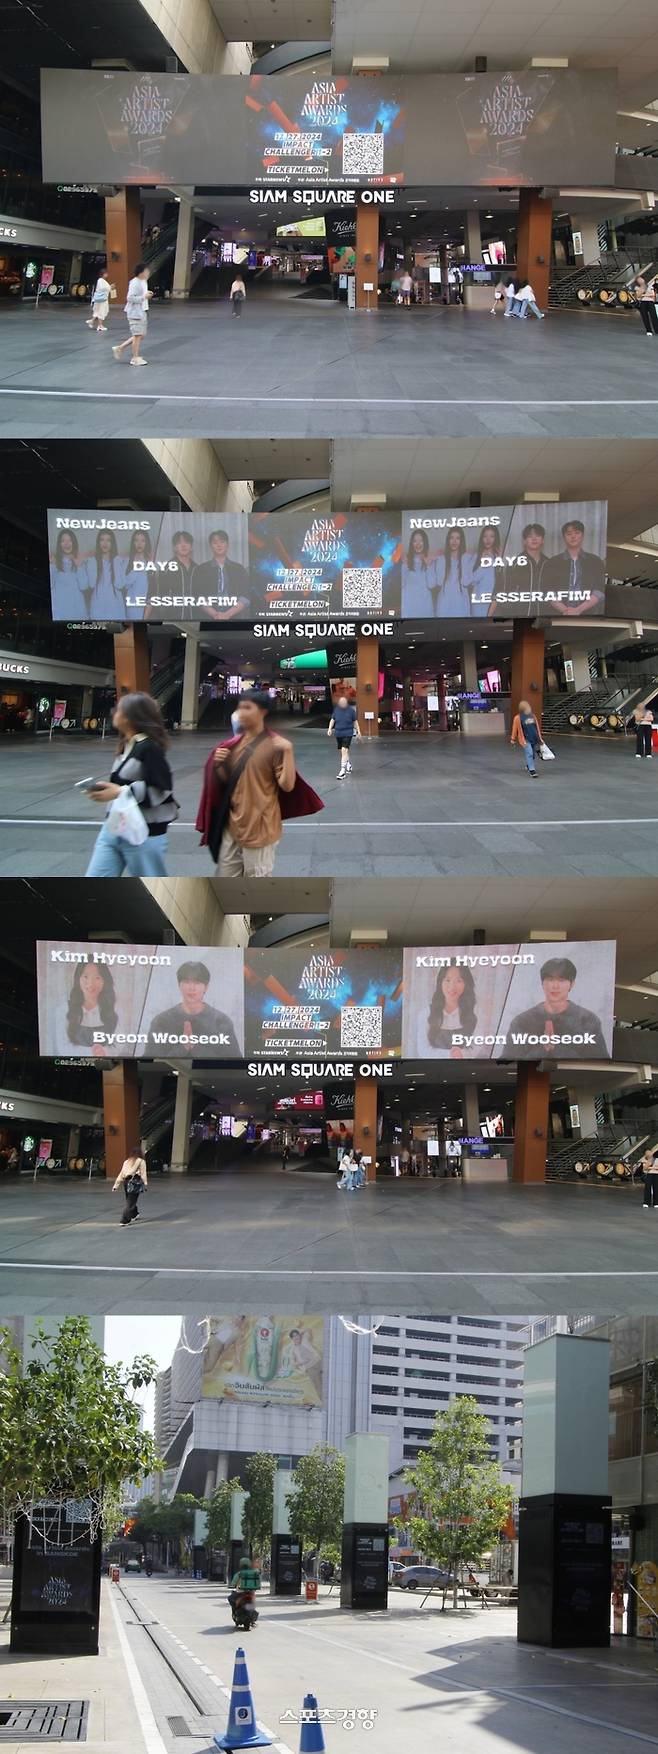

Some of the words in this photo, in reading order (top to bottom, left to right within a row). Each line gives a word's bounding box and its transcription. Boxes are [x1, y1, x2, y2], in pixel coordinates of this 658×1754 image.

[132, 86, 160, 98] ASIA
[312, 82, 336, 93] ASIA
[493, 86, 521, 98] ASIA
[124, 98, 170, 110] ARTIST
[304, 94, 344, 105] ARTIST
[483, 97, 532, 111] ARTIST
[120, 110, 173, 122] AWARDS
[301, 105, 347, 116] AWARDS
[480, 109, 535, 123] AWARDS
[311, 116, 339, 127] 2024
[131, 122, 163, 134] 2024
[489, 122, 524, 136] 2024
[250, 190, 287, 203] SIAM
[293, 190, 355, 206] SQUARE
[361, 190, 394, 203] ONE
[56, 518, 150, 530] NewJeans
[312, 519, 335, 530] ASIA
[410, 516, 500, 529] NewJeans
[304, 530, 344, 541] ARTIST
[301, 541, 346, 551] AWARDS
[310, 552, 338, 563] 2024
[480, 556, 528, 568] DAY6
[133, 561, 178, 571] DAY6
[126, 596, 147, 606] LE
[150, 596, 238, 607] SSERAFIM
[471, 593, 493, 604] LE
[496, 590, 591, 603] SSERAFIM
[253, 624, 289, 637] SIAM
[295, 624, 355, 639] SQUARE
[361, 623, 393, 636] ONE
[51, 950, 88, 963] Kim
[93, 952, 171, 967] Hyeyoon
[310, 955, 334, 966] ASIA
[416, 956, 451, 968] Kim
[456, 953, 535, 968] Hyeyoon
[302, 966, 342, 977] ARTIST
[299, 977, 344, 988] AWARDS
[308, 988, 336, 1000] 2024
[93, 1032, 148, 1045] Byeon
[152, 1032, 230, 1045] Wooseok
[452, 1034, 507, 1047] Byeon
[512, 1032, 596, 1045] Wooseok
[248, 1063, 285, 1076] SIAM
[291, 1064, 353, 1079] SQUARE
[359, 1064, 392, 1076] ONE
[0, 1101, 14, 1110] KS
